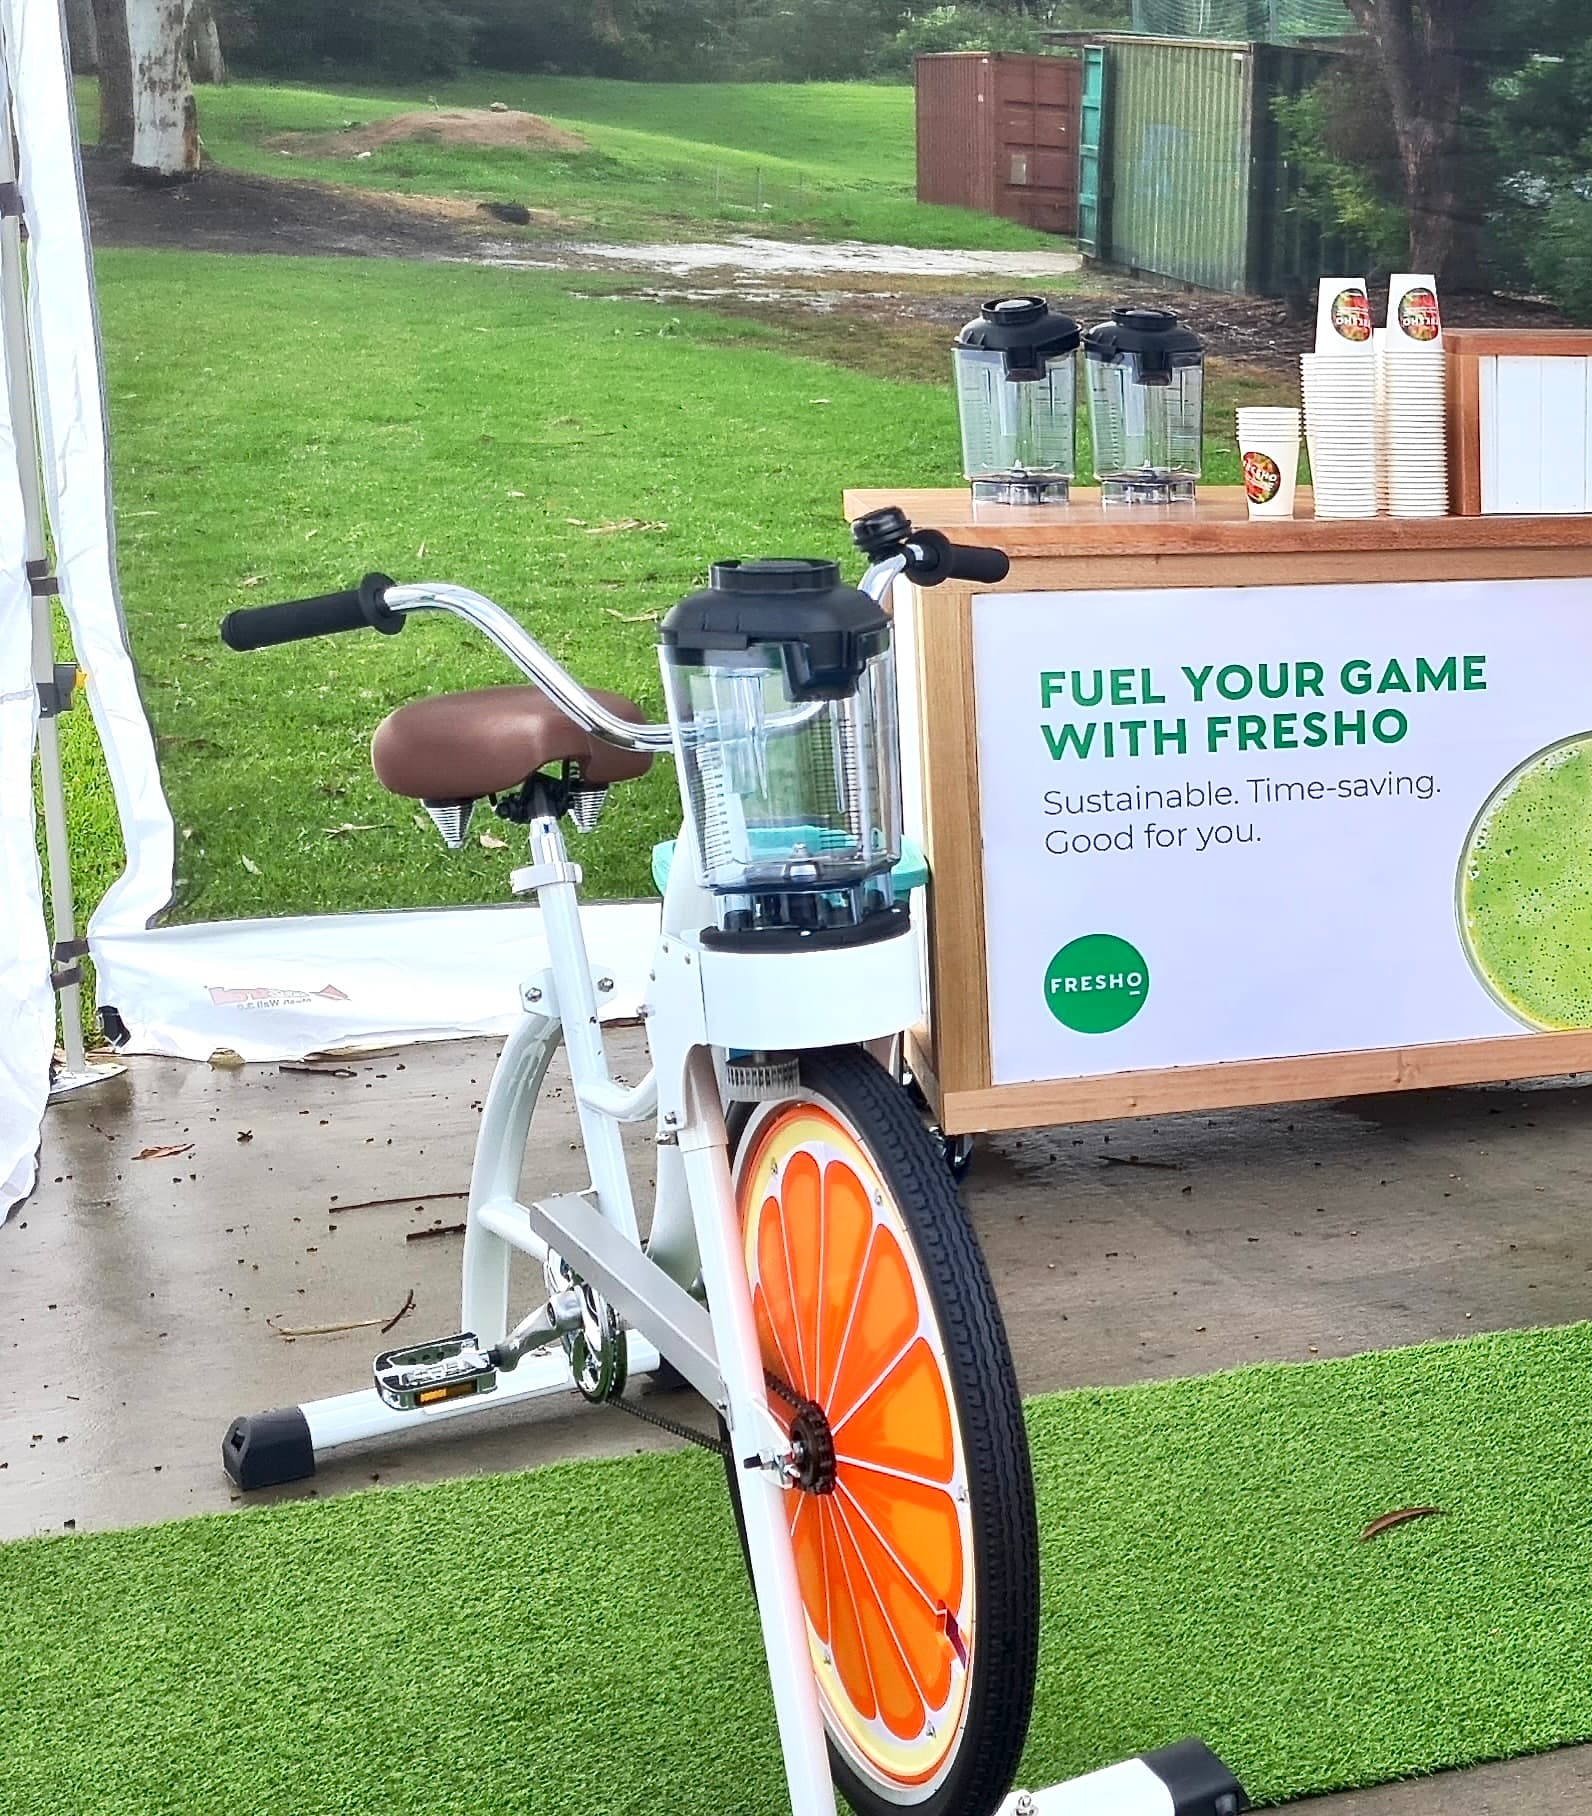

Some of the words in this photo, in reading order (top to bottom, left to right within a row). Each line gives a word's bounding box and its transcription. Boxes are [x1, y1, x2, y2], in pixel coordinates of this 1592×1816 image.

[1040, 668, 1166, 708] FUEL
[1181, 662, 1324, 702] YOUR
[1340, 656, 1487, 695] GAME
[1040, 718, 1187, 761] WITH
[1207, 709, 1408, 753] FRESHO
[1044, 780, 1239, 815] Sustainable.
[1246, 771, 1441, 803] Time-saving.
[1045, 824, 1134, 854] Good
[1144, 823, 1187, 848] for
[1196, 823, 1261, 851] you.
[1050, 972, 1142, 996] FRESHO
